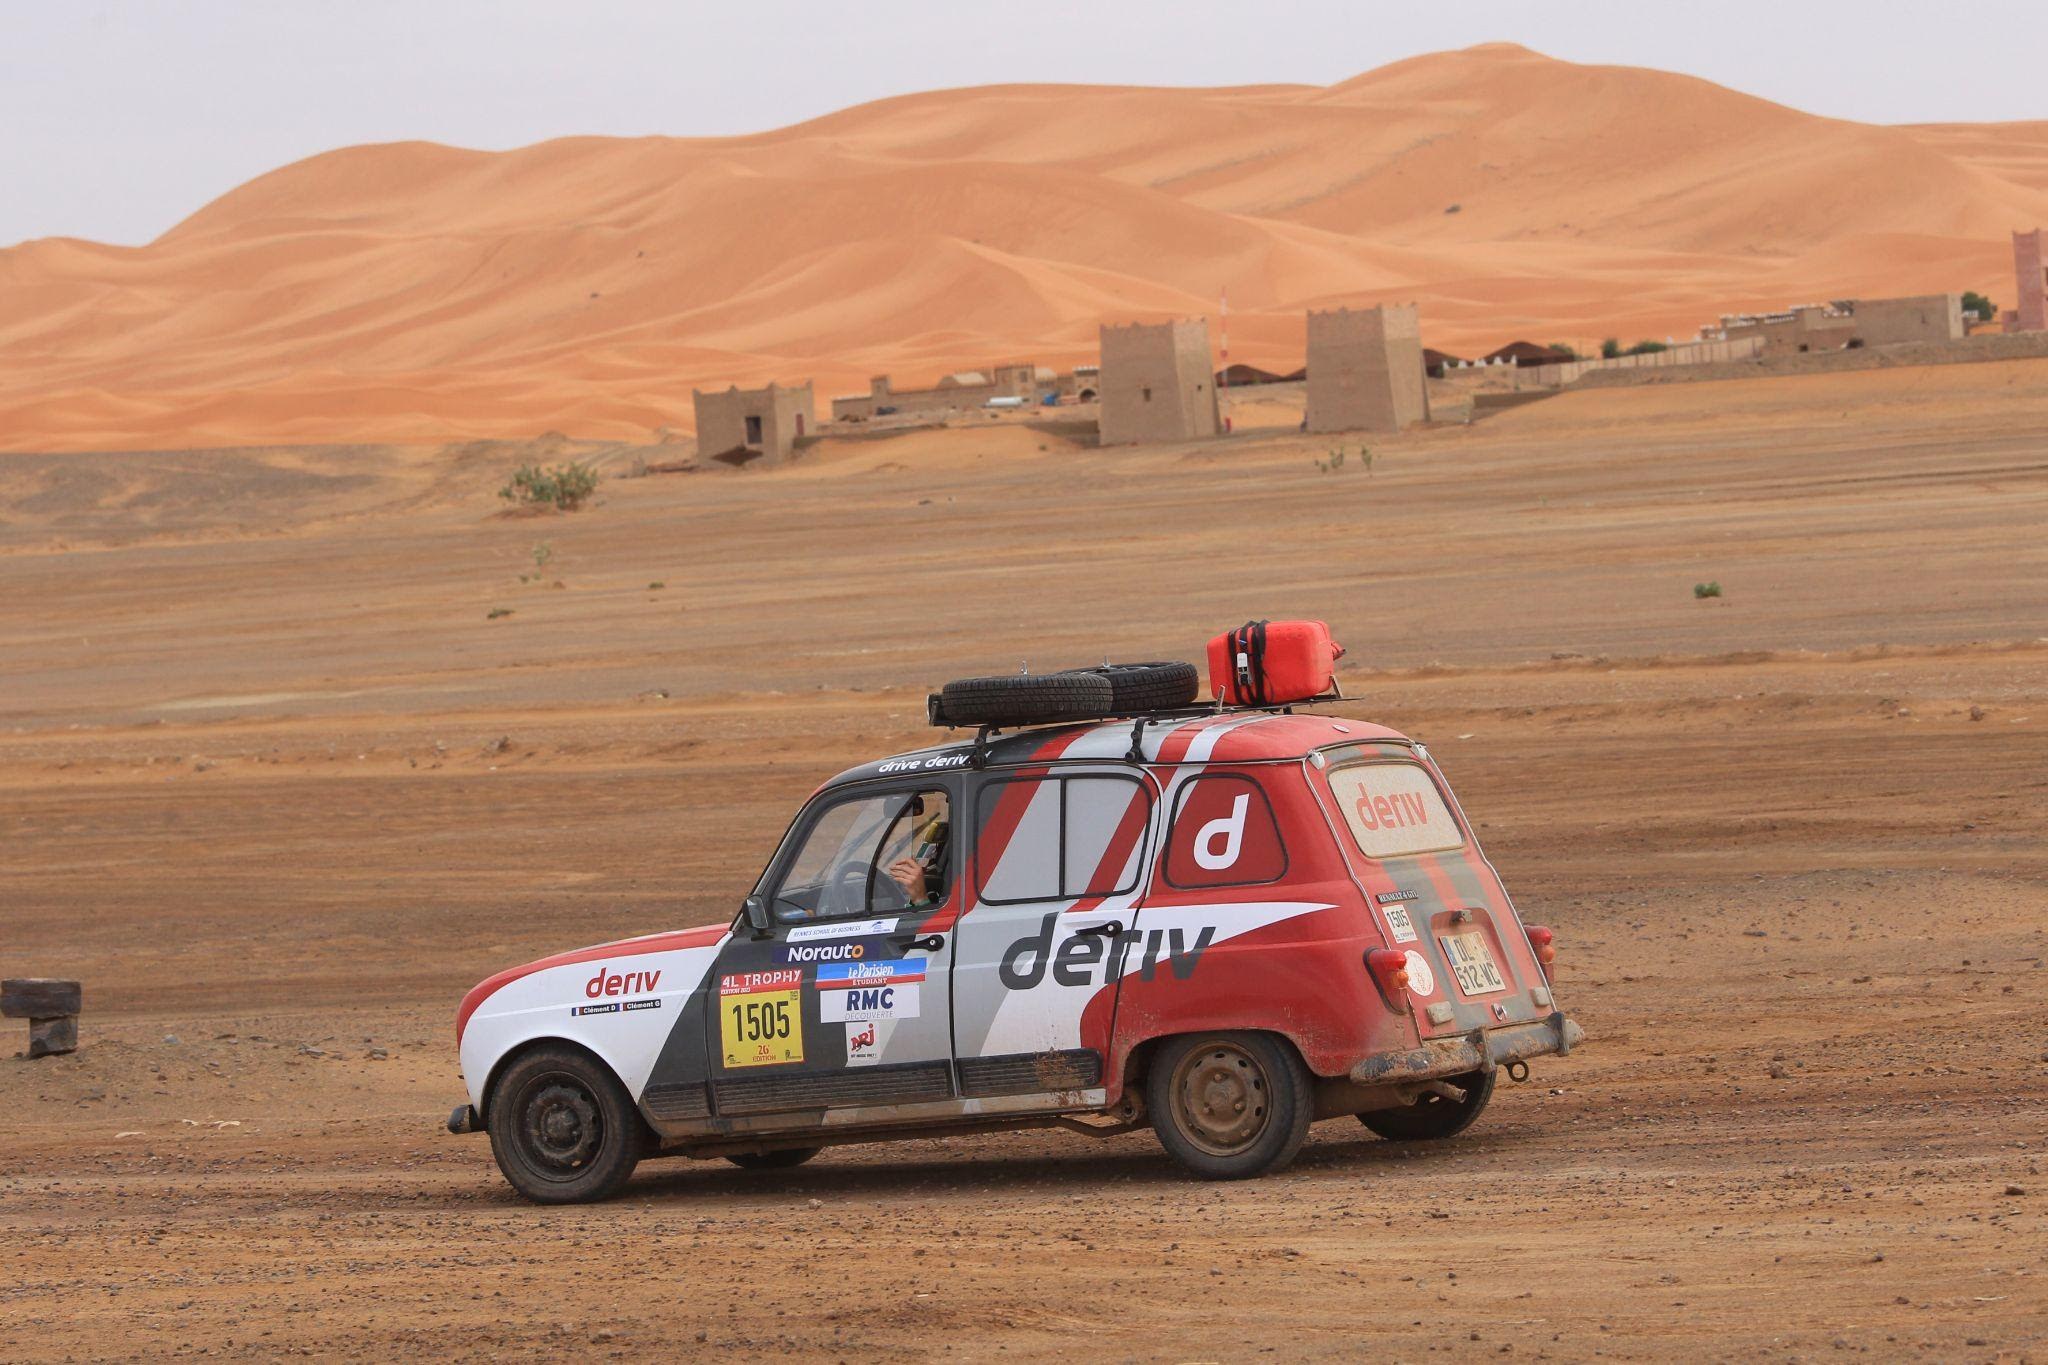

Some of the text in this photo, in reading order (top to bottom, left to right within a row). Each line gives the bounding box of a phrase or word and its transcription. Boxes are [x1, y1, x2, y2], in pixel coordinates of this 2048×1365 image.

[879, 760, 921, 773] drive
[1355, 782, 1428, 831] deriv
[1193, 792, 1250, 870] d
[1386, 909, 1410, 928] 1505
[787, 943, 864, 962] Norauto
[999, 911, 1216, 990] deriv
[585, 967, 662, 999] deriv
[722, 969, 802, 988] 4L TROPHY
[627, 1002, 653, 1010] Clément
[846, 987, 895, 1011] RMC
[583, 1006, 610, 1014] Clément
[732, 1000, 790, 1042] 1505
